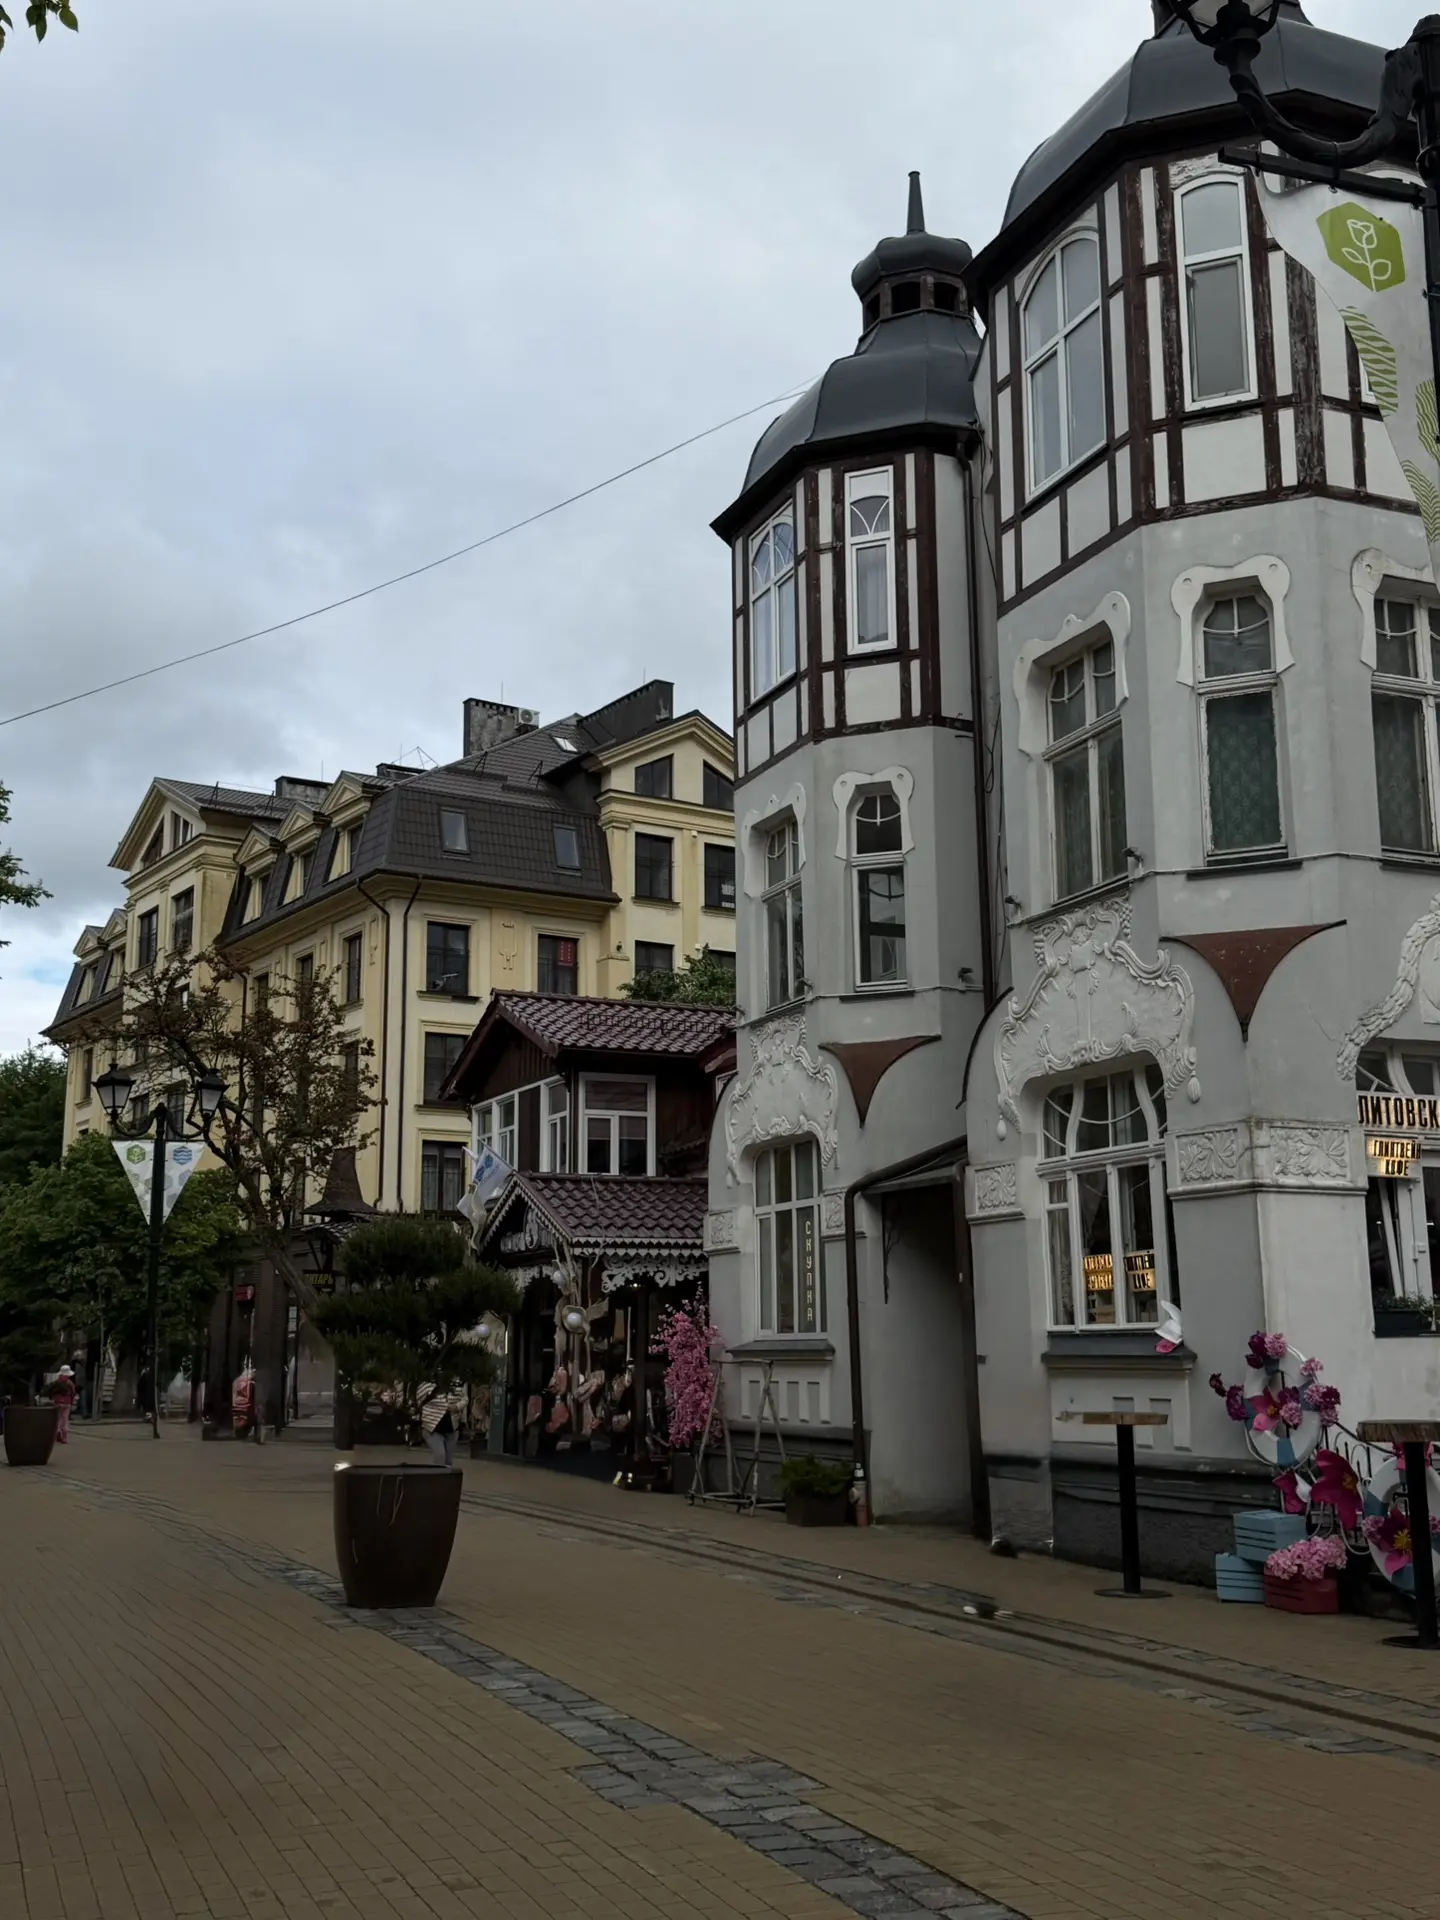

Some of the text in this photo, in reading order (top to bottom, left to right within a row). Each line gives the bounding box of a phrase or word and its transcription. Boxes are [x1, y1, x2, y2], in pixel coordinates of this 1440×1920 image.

[1358, 1096, 1440, 1128] ЛИТОВСК
[1373, 1140, 1421, 1159] ГЛИНТВЕЙН
[1385, 1159, 1409, 1176] КОФЕ
[804, 1220, 813, 1321] СКУПКА
